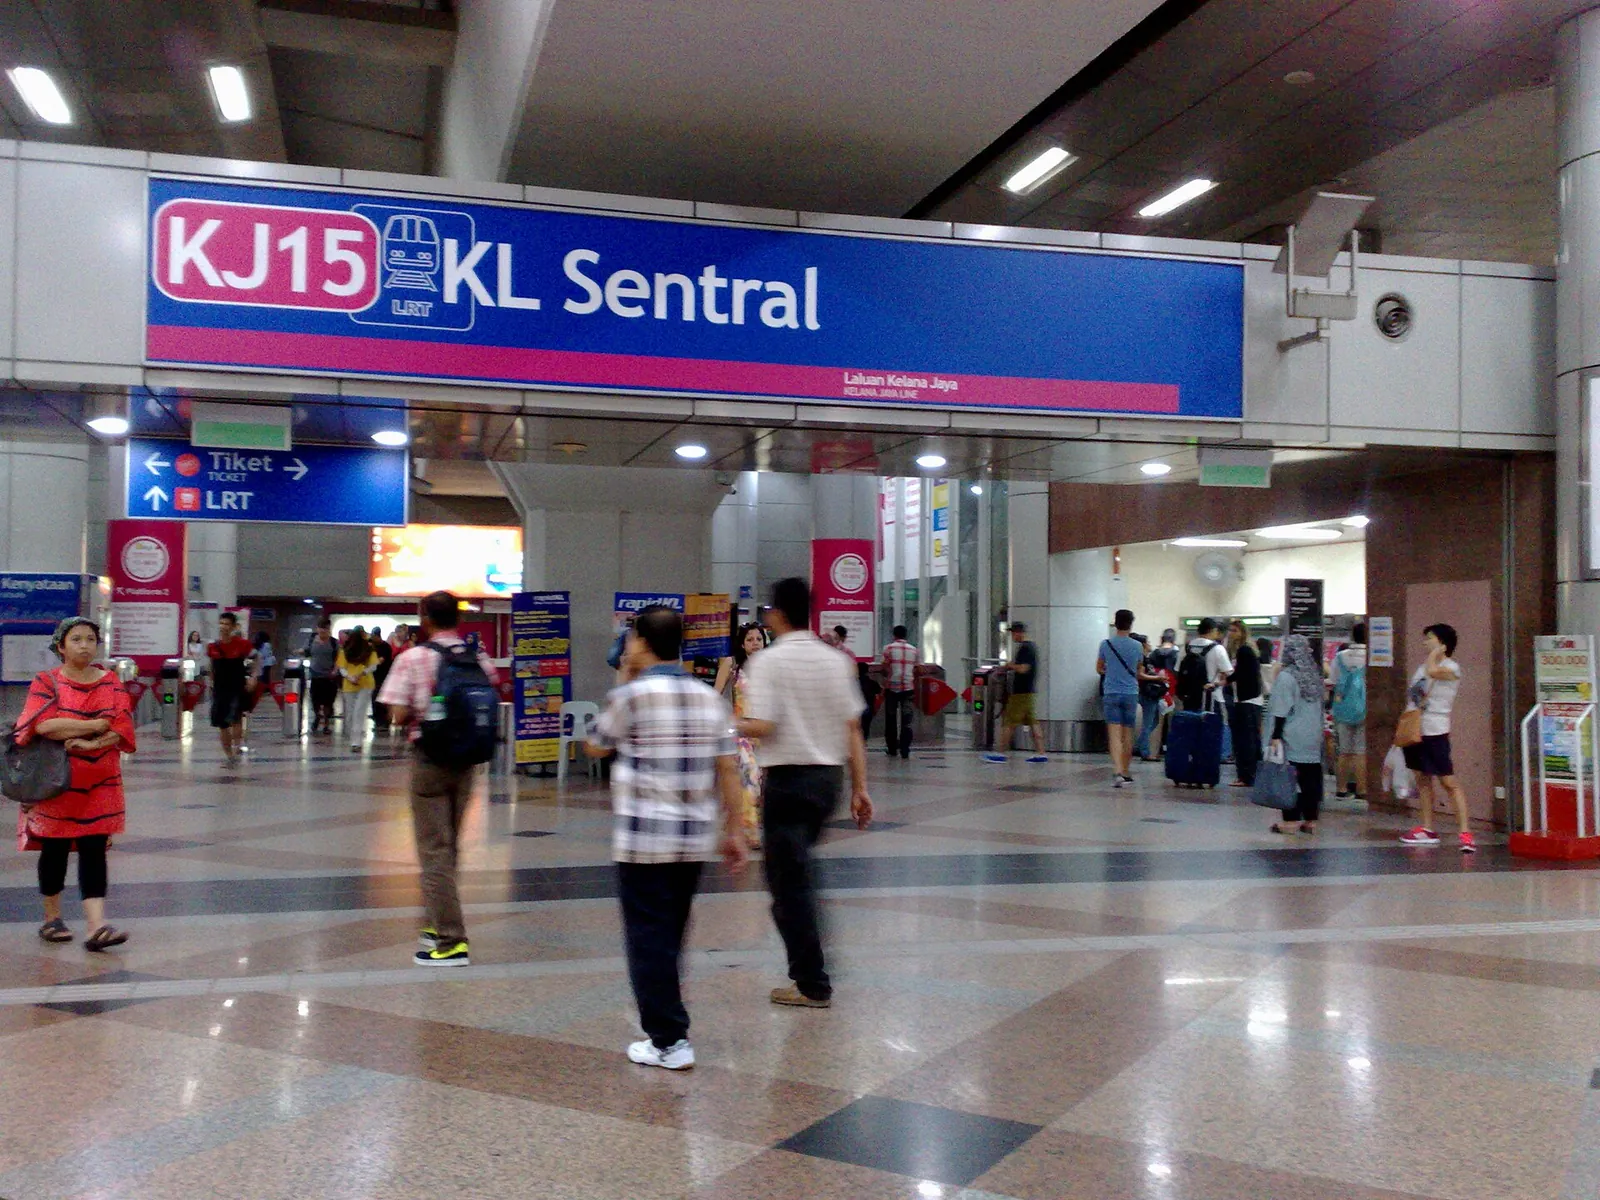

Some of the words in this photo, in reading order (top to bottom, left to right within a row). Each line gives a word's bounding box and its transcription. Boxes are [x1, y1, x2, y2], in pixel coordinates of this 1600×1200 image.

[168, 216, 367, 297] KJ15
[443, 238, 541, 310] KL
[563, 248, 821, 331] Sentral
[391, 299, 434, 317] LRT
[843, 372, 885, 386] Laluan
[887, 374, 928, 389] Kelana
[929, 377, 958, 392] Jaya
[843, 386, 878, 397] KELANA
[879, 388, 899, 398] JAYA
[901, 389, 919, 399] LINE
[208, 451, 273, 472] Tiket
[207, 471, 248, 482] TICKET
[206, 490, 254, 510] LRT
